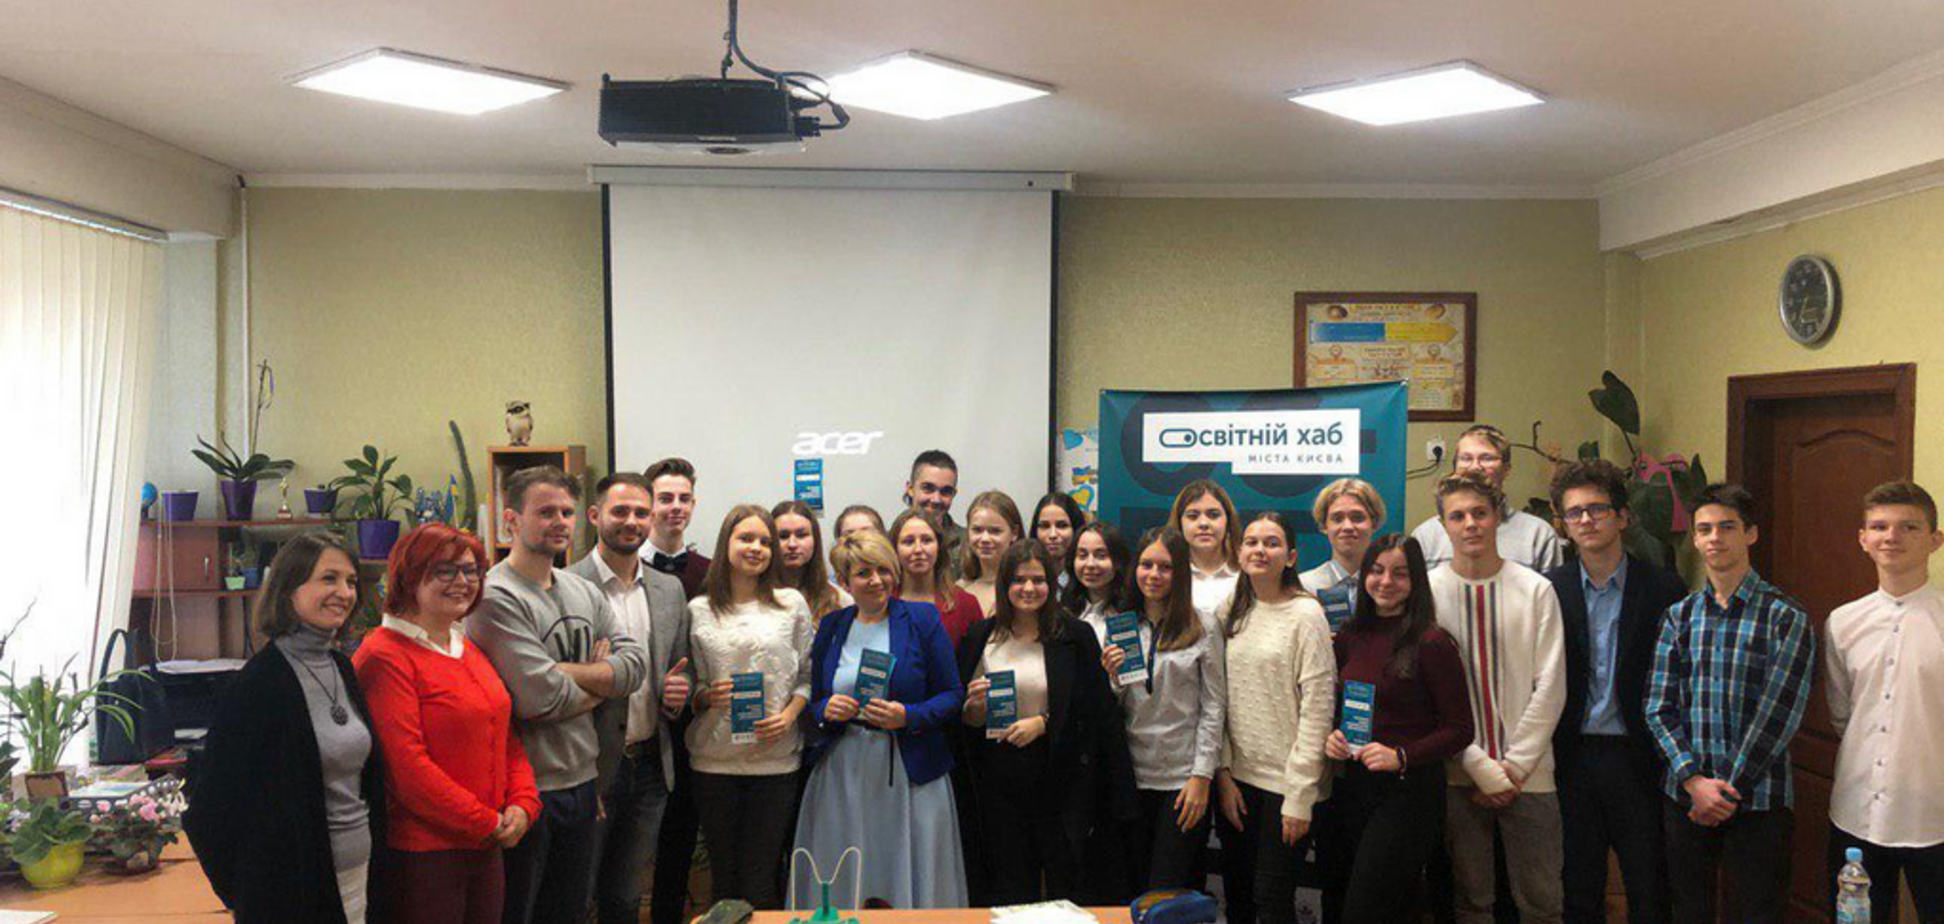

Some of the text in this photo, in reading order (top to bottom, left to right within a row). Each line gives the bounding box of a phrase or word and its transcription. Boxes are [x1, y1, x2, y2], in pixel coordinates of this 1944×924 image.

[792, 431, 884, 455] acer
[1297, 421, 1342, 446] хаб
[1248, 453, 1290, 463] МІСТА
